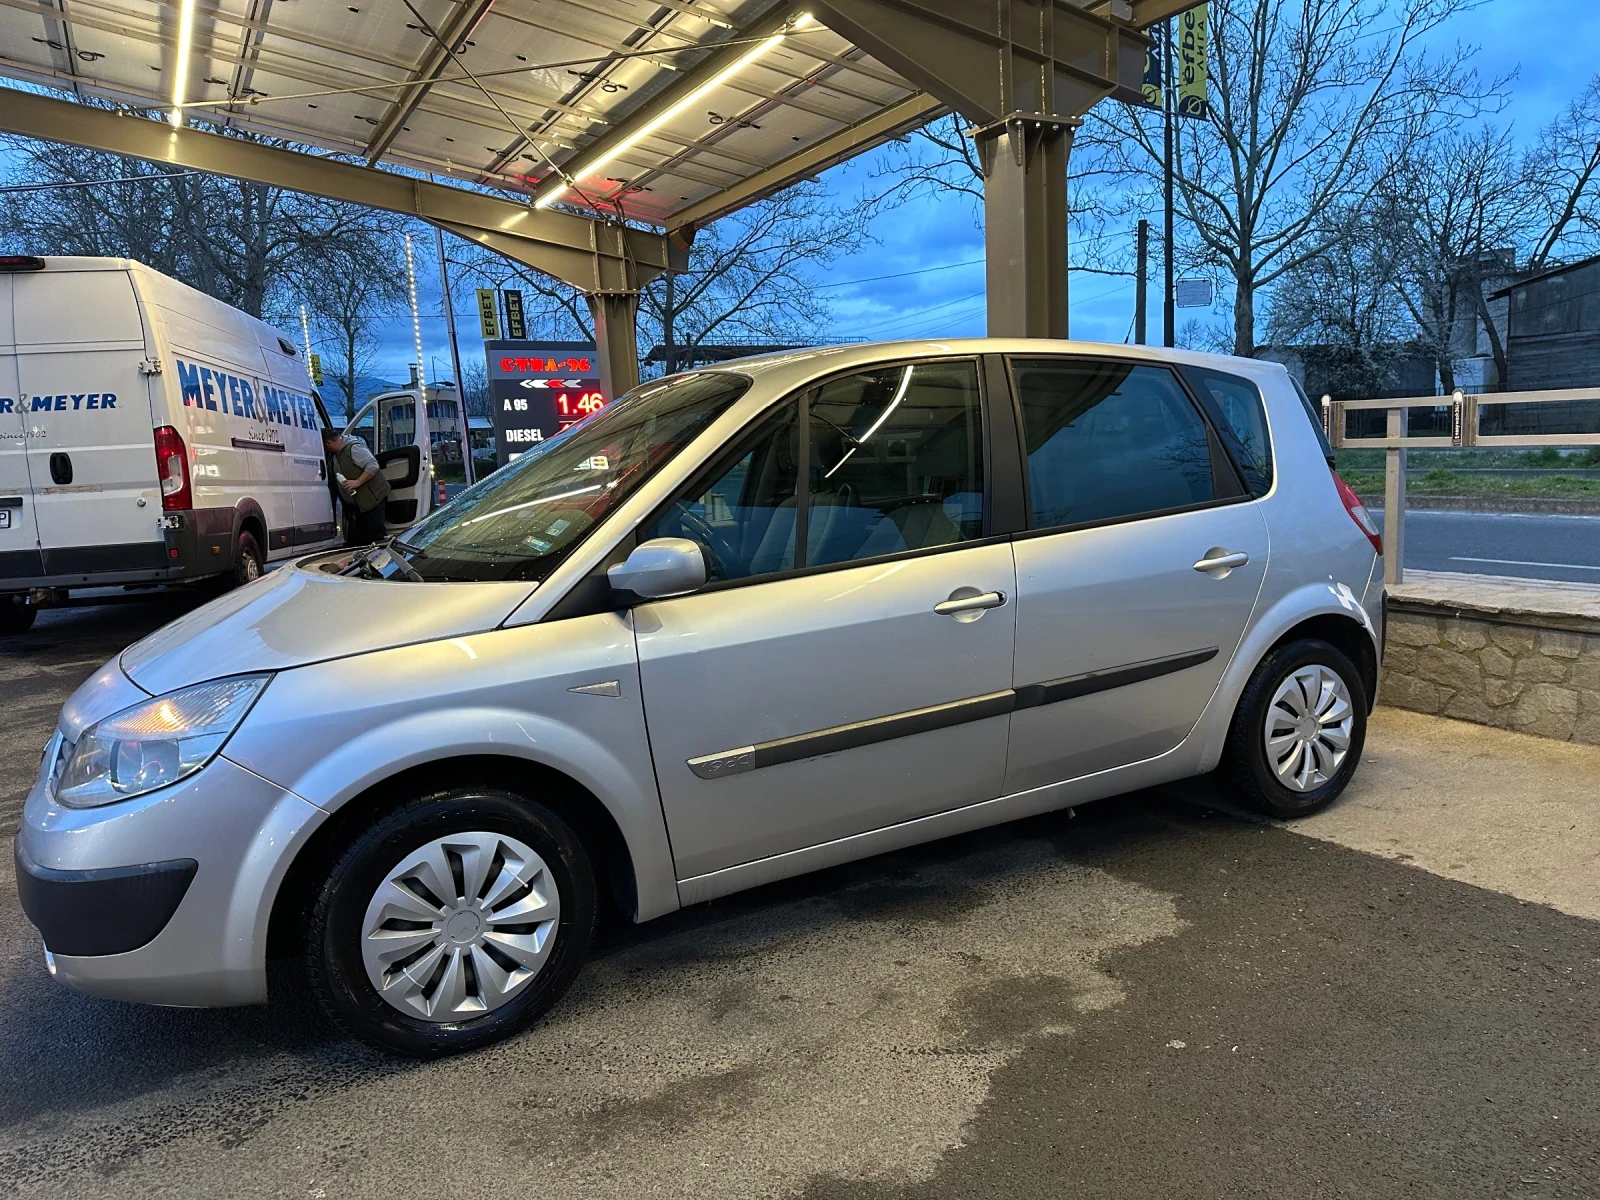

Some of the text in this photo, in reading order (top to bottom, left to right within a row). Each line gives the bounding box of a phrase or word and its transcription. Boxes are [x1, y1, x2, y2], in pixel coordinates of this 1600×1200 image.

[1182, 11, 1195, 84] efbe
[481, 292, 495, 335] EFBET
[508, 293, 522, 337] EFBET
[504, 399, 528, 411] A 95
[559, 393, 604, 414] 1.46
[26, 430, 47, 438] 1902
[265, 429, 279, 443] 1902
[506, 428, 544, 442] DIESEL
